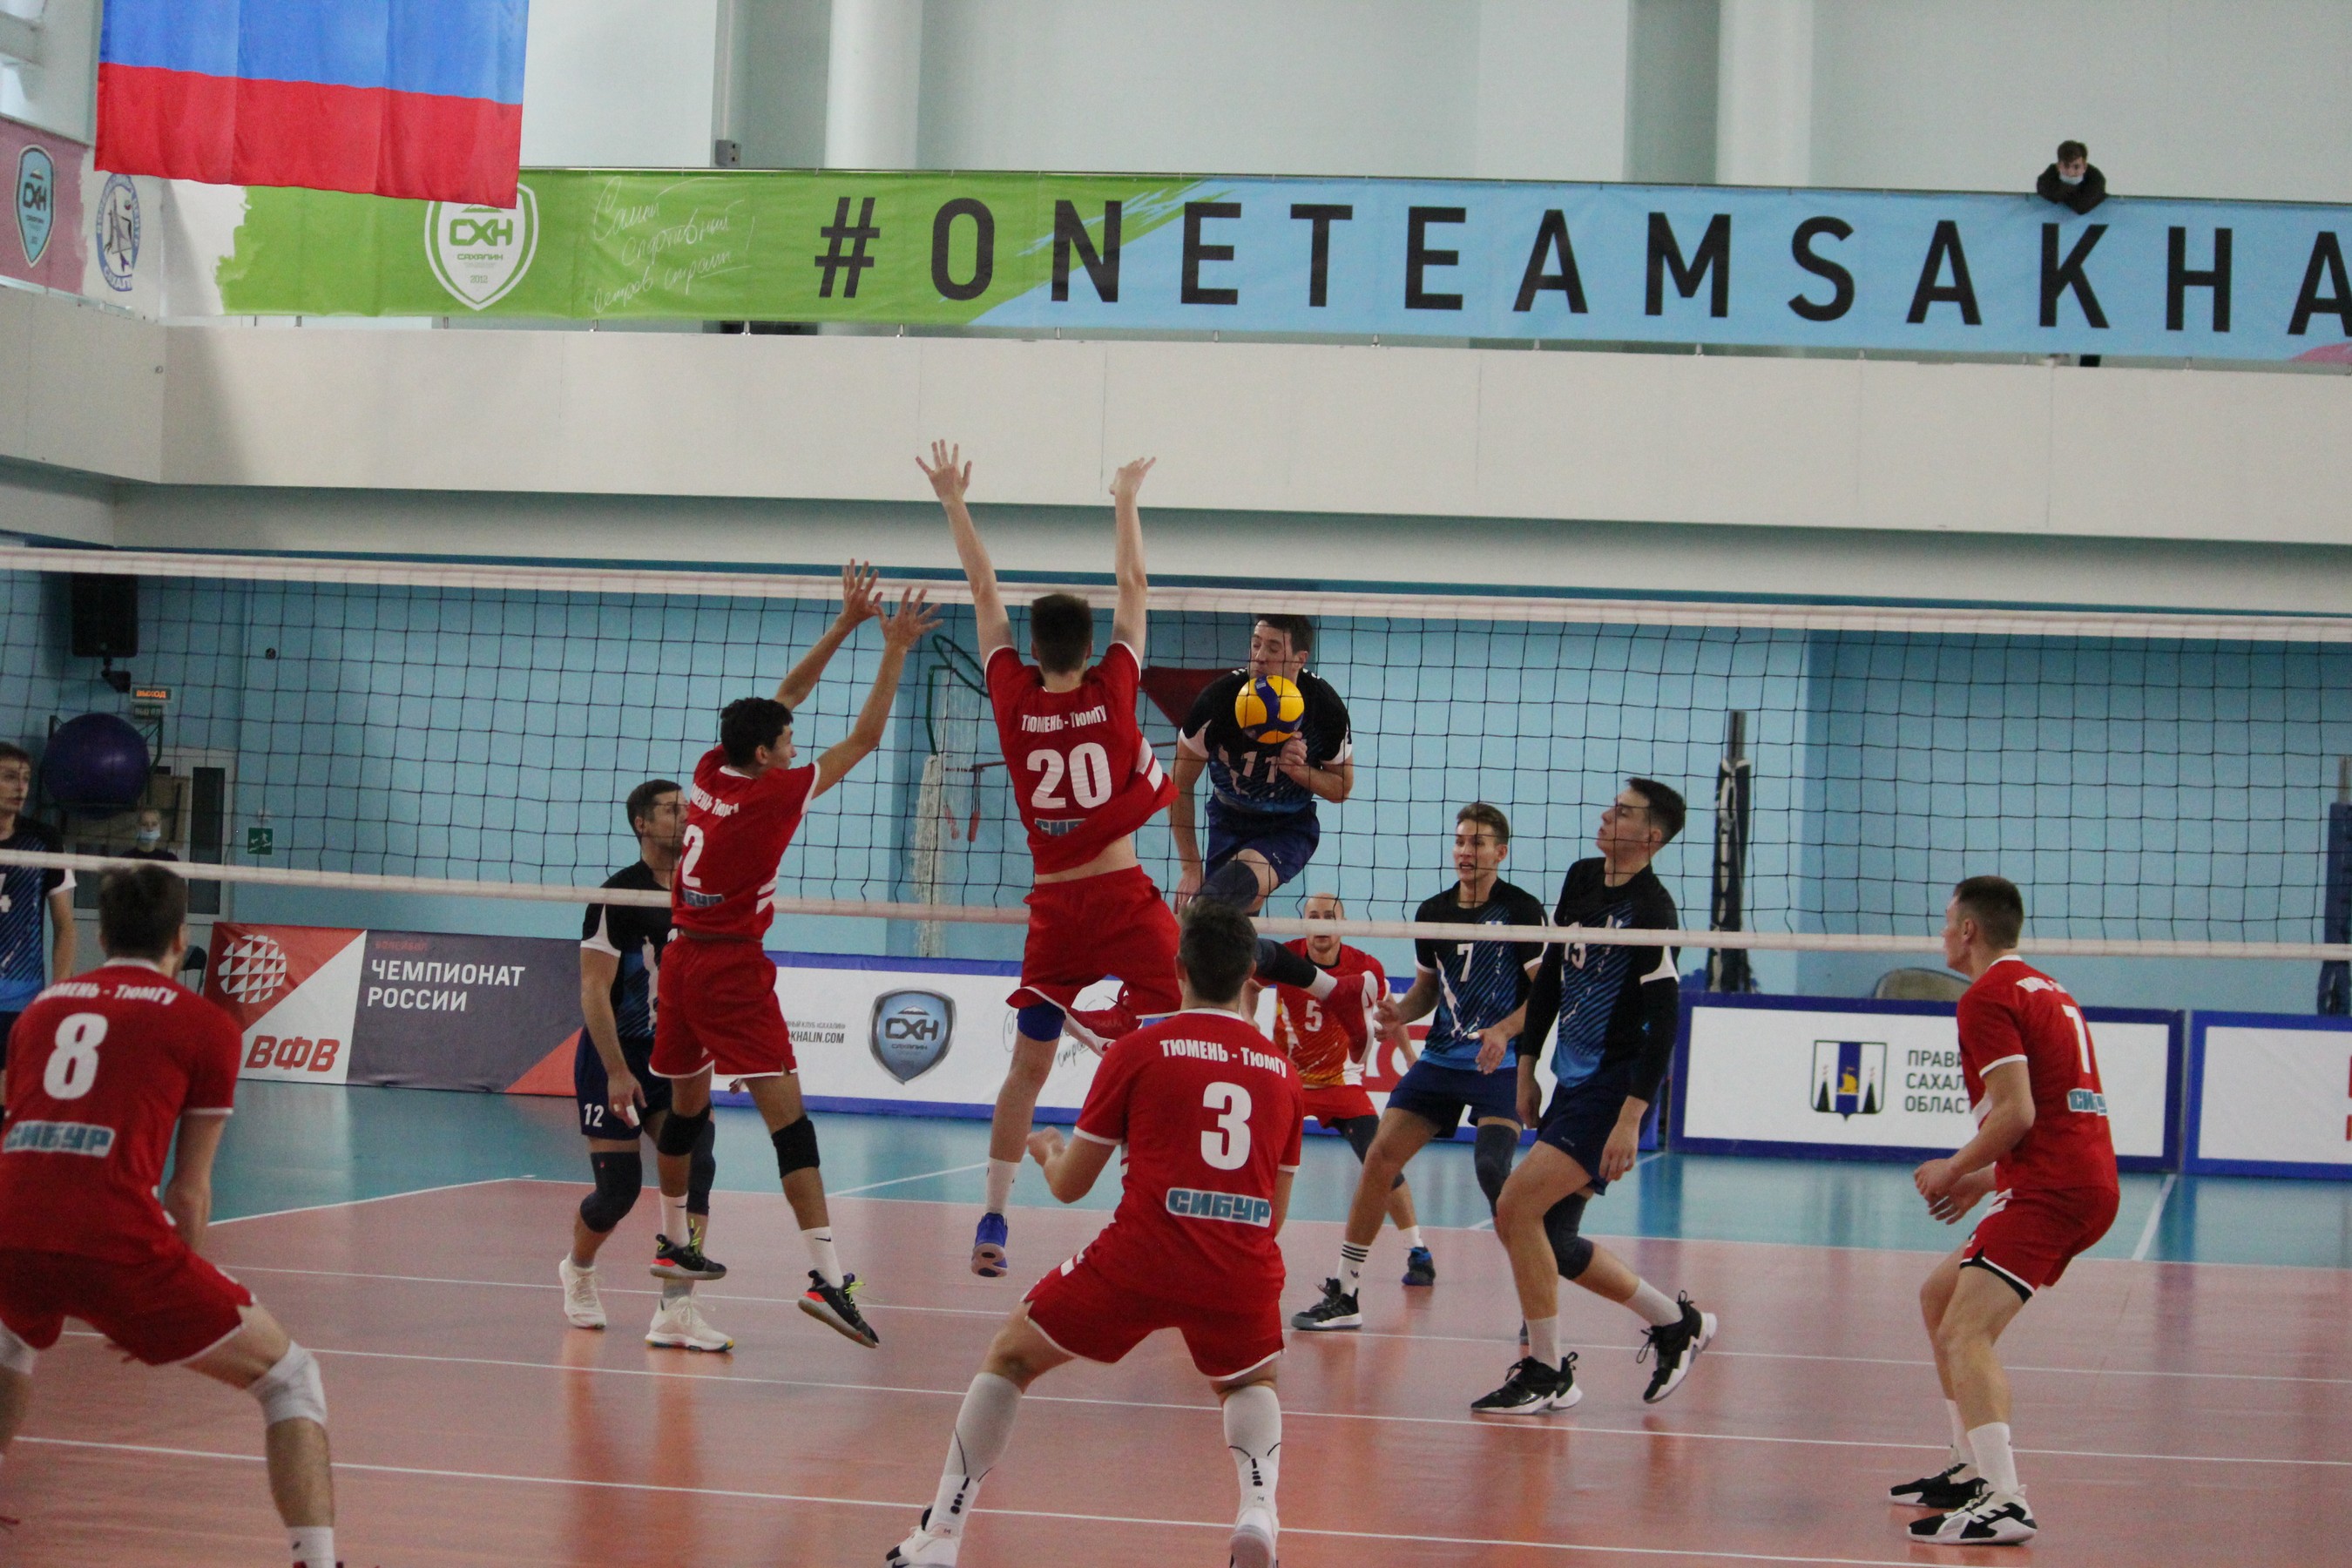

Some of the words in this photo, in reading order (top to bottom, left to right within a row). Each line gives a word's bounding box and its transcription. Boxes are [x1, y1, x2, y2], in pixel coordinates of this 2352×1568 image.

[136, 689, 166, 699] ВЫХОД
[1021, 713, 1064, 733] ТЮМЕНЬ
[1026, 741, 1112, 808] 20
[1240, 750, 1280, 784] 11
[681, 824, 705, 889] 2
[371, 959, 526, 987] ЧЕМПИОНАТ
[1456, 943, 1474, 983] 7
[367, 986, 468, 1012] РОССИИ
[1304, 1000, 1323, 1032] 5
[790, 1031, 845, 1044] KHALIN.COM
[1159, 1039, 1228, 1063] ТЮМЕНЬ
[44, 1012, 109, 1100] 8
[245, 1034, 341, 1072] ВФВ
[1906, 1072, 1966, 1091] САХАЛ
[584, 1103, 605, 1128] 12
[1905, 1096, 1973, 1115] ОБЛАСТ
[1200, 1081, 1253, 1171] 3
[1167, 1188, 1271, 1223] СИБУР
